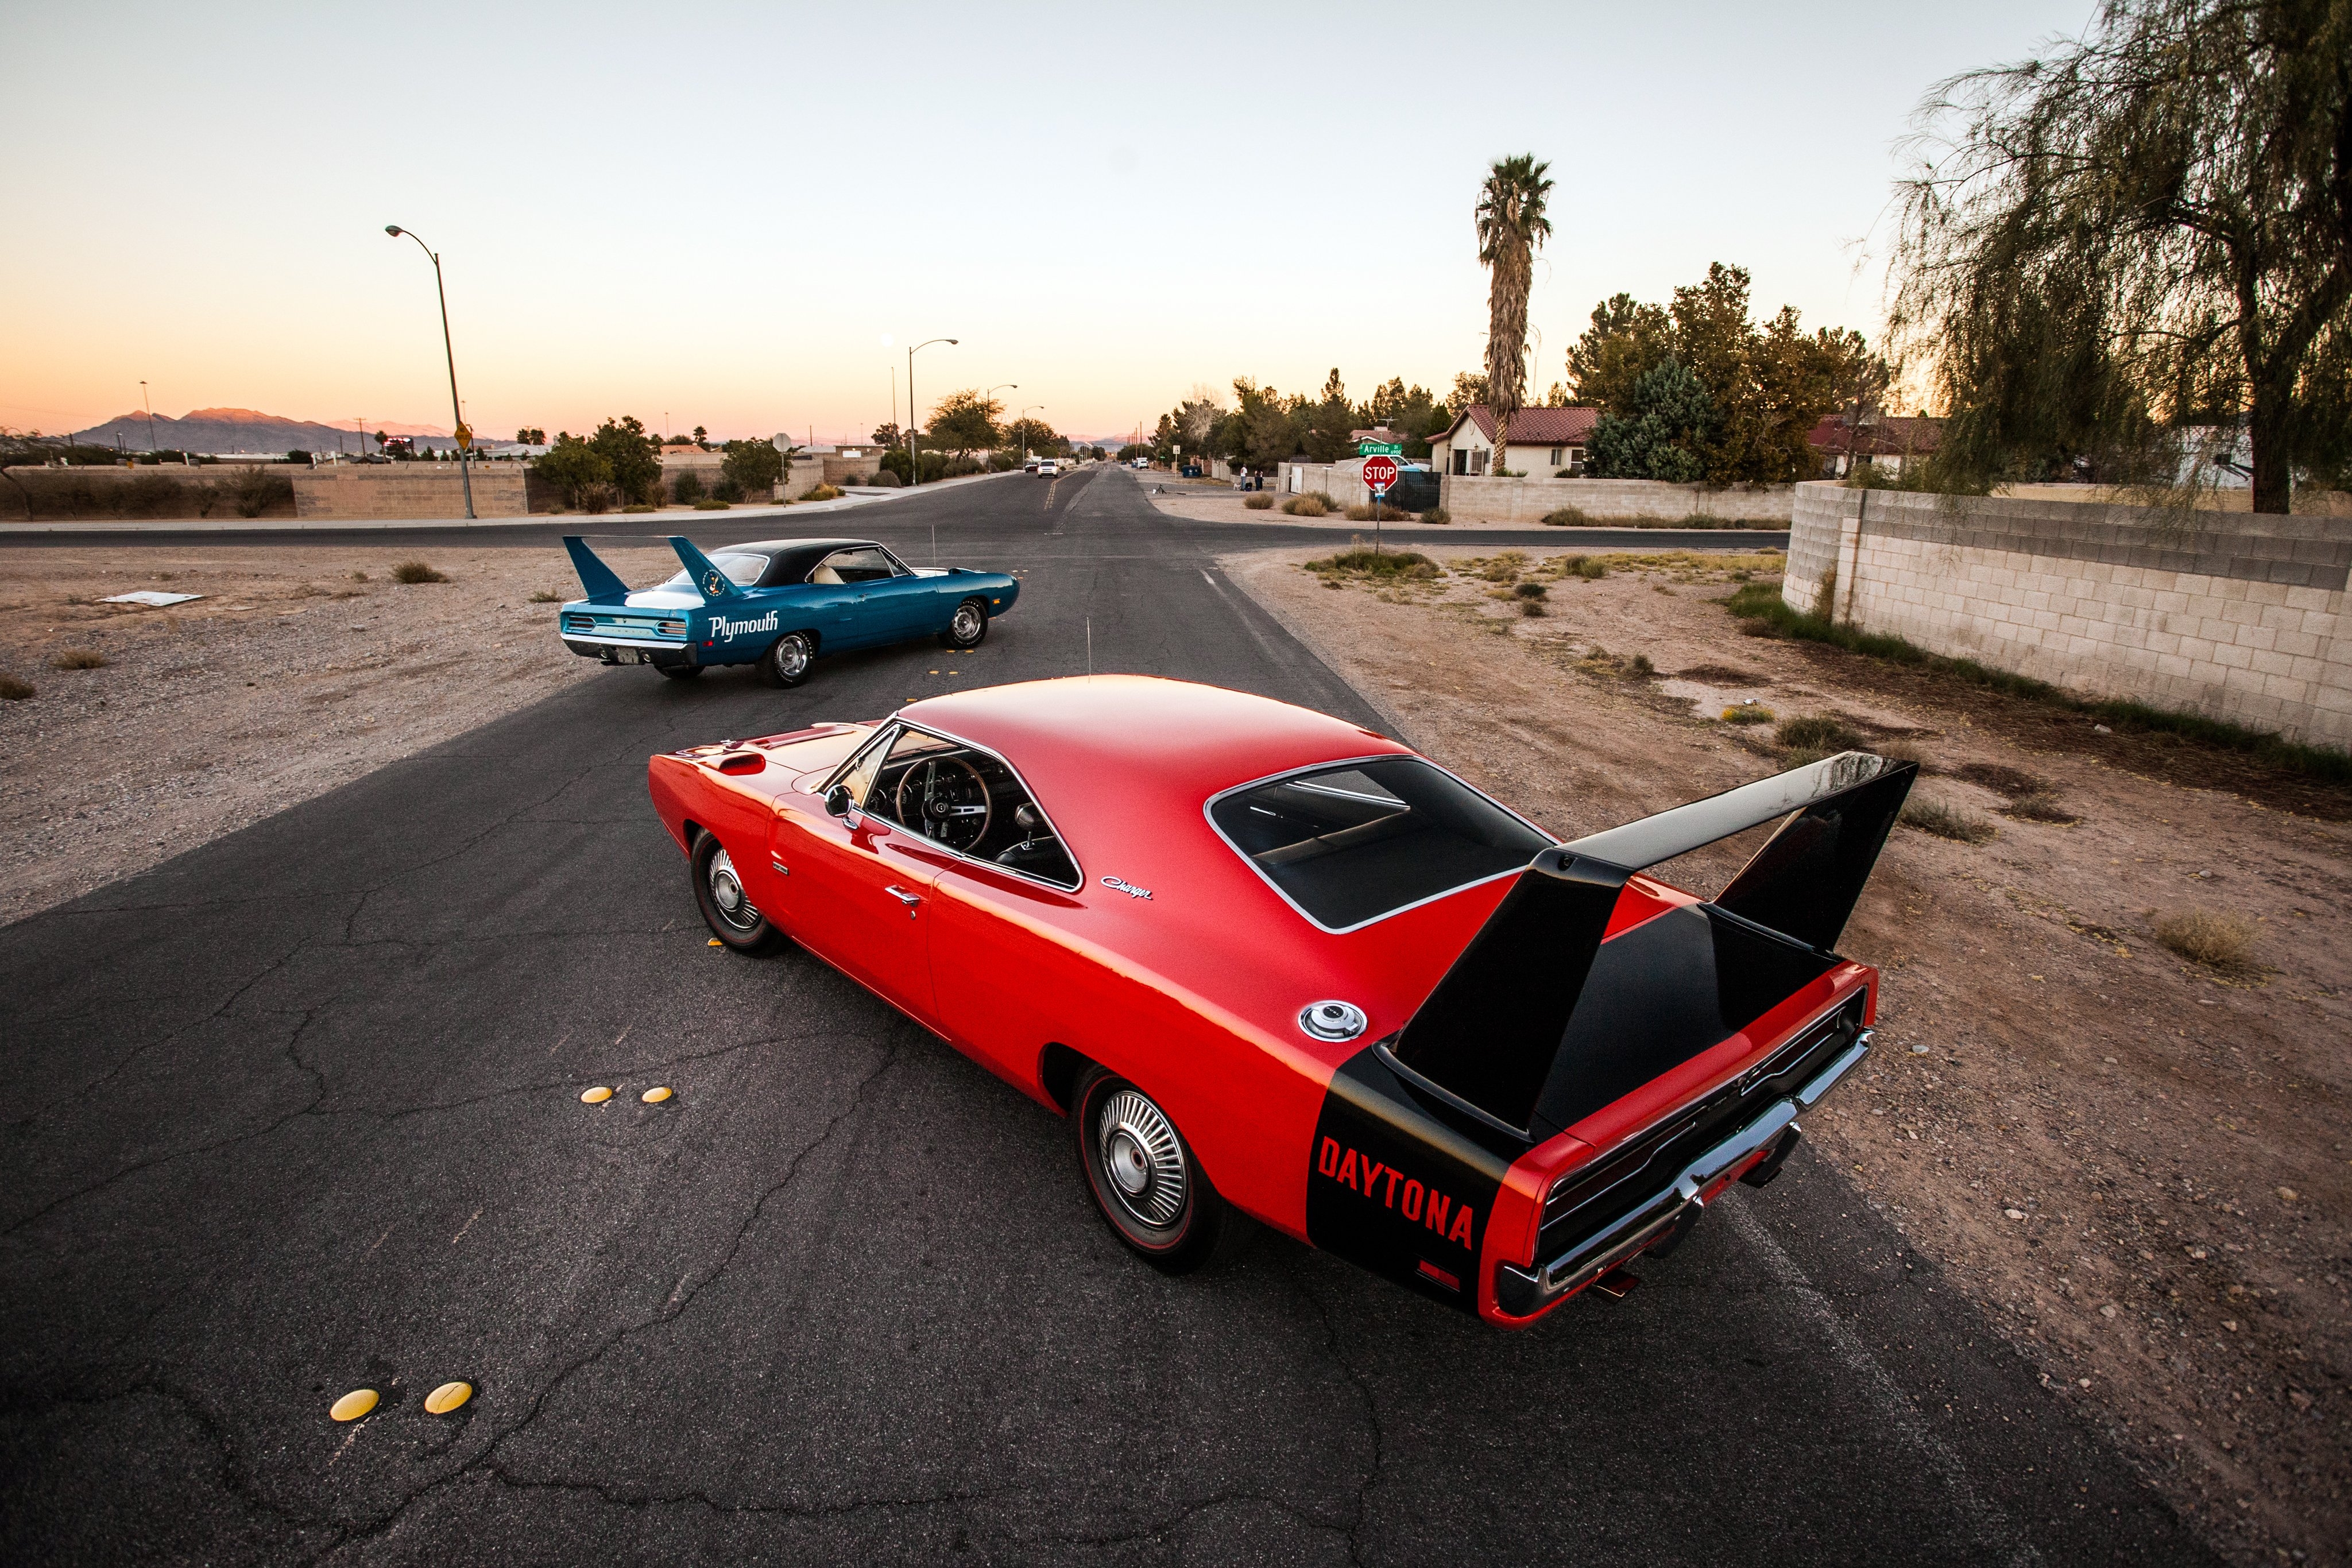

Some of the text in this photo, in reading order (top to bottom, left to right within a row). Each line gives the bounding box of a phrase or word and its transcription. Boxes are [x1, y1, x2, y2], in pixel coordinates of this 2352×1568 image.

[1364, 445, 1389, 453] Arville
[1364, 466, 1395, 480] STOP
[708, 610, 778, 642] Plymouth
[1100, 876, 1152, 900] Charger
[1318, 1136, 1473, 1250] DAYTONA
